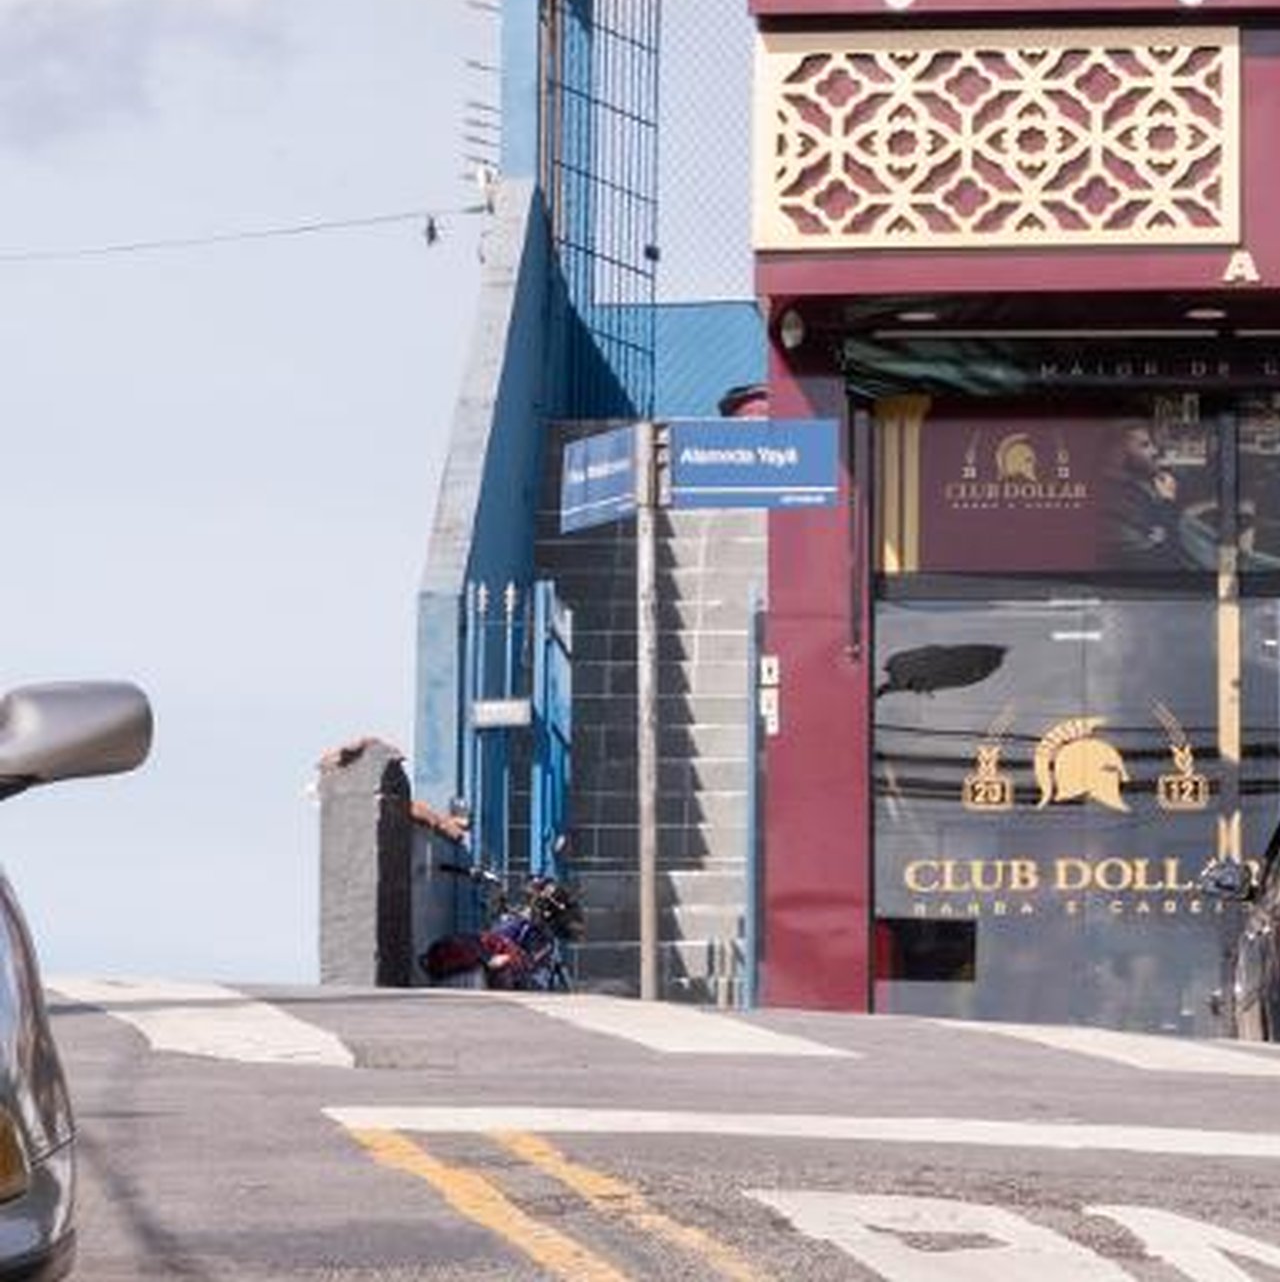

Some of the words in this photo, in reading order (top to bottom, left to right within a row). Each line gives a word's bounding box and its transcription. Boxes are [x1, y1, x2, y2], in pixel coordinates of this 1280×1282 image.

[1222, 250, 1261, 282] A
[1169, 782, 1194, 802] 12
[904, 859, 1039, 892] CLUB
[1055, 857, 1260, 892] DOLL
